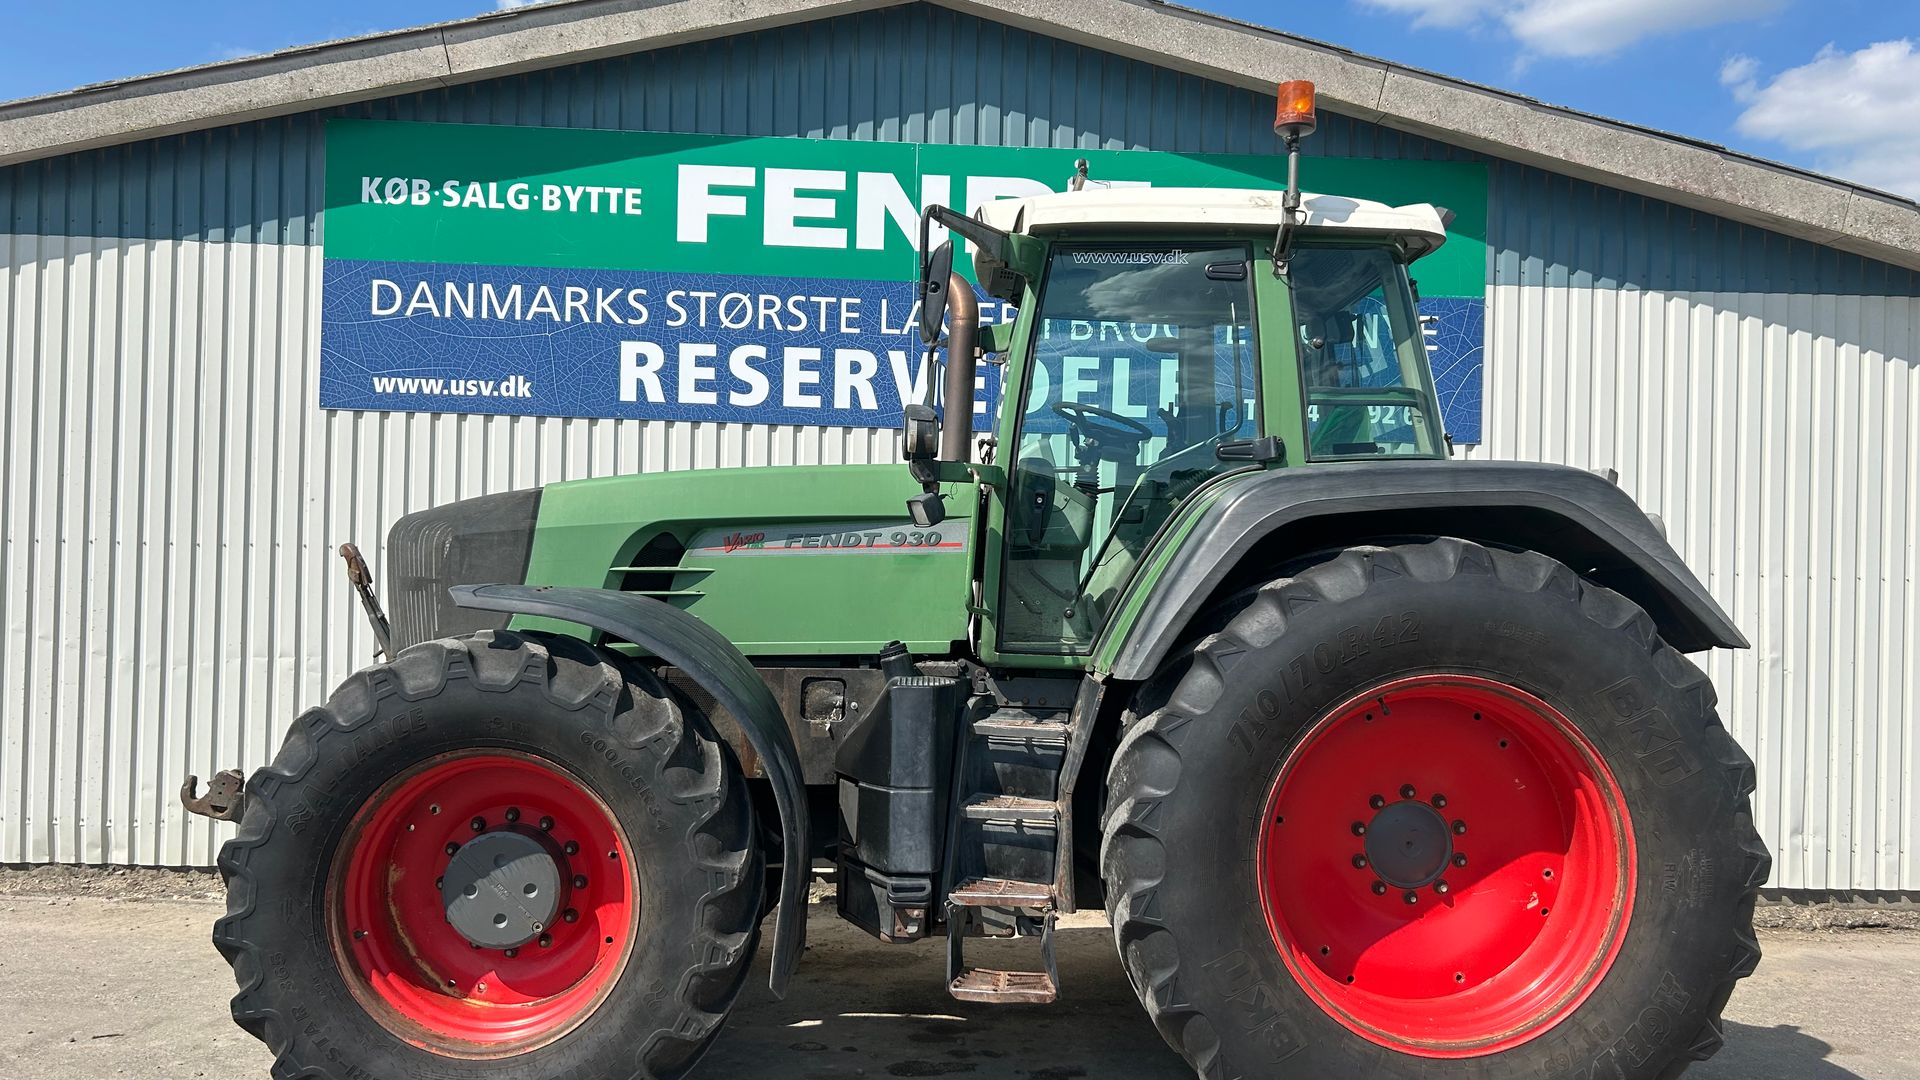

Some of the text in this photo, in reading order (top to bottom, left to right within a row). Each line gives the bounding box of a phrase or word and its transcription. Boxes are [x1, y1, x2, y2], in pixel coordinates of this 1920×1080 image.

[676, 164, 1151, 254] FEN
[1073, 250, 1189, 265] www.usv.dk
[371, 279, 649, 325] DANMARKS
[666, 289, 862, 333] STØRSTE
[373, 375, 532, 398] www.usv.dk
[784, 531, 943, 549] FENDT 930
